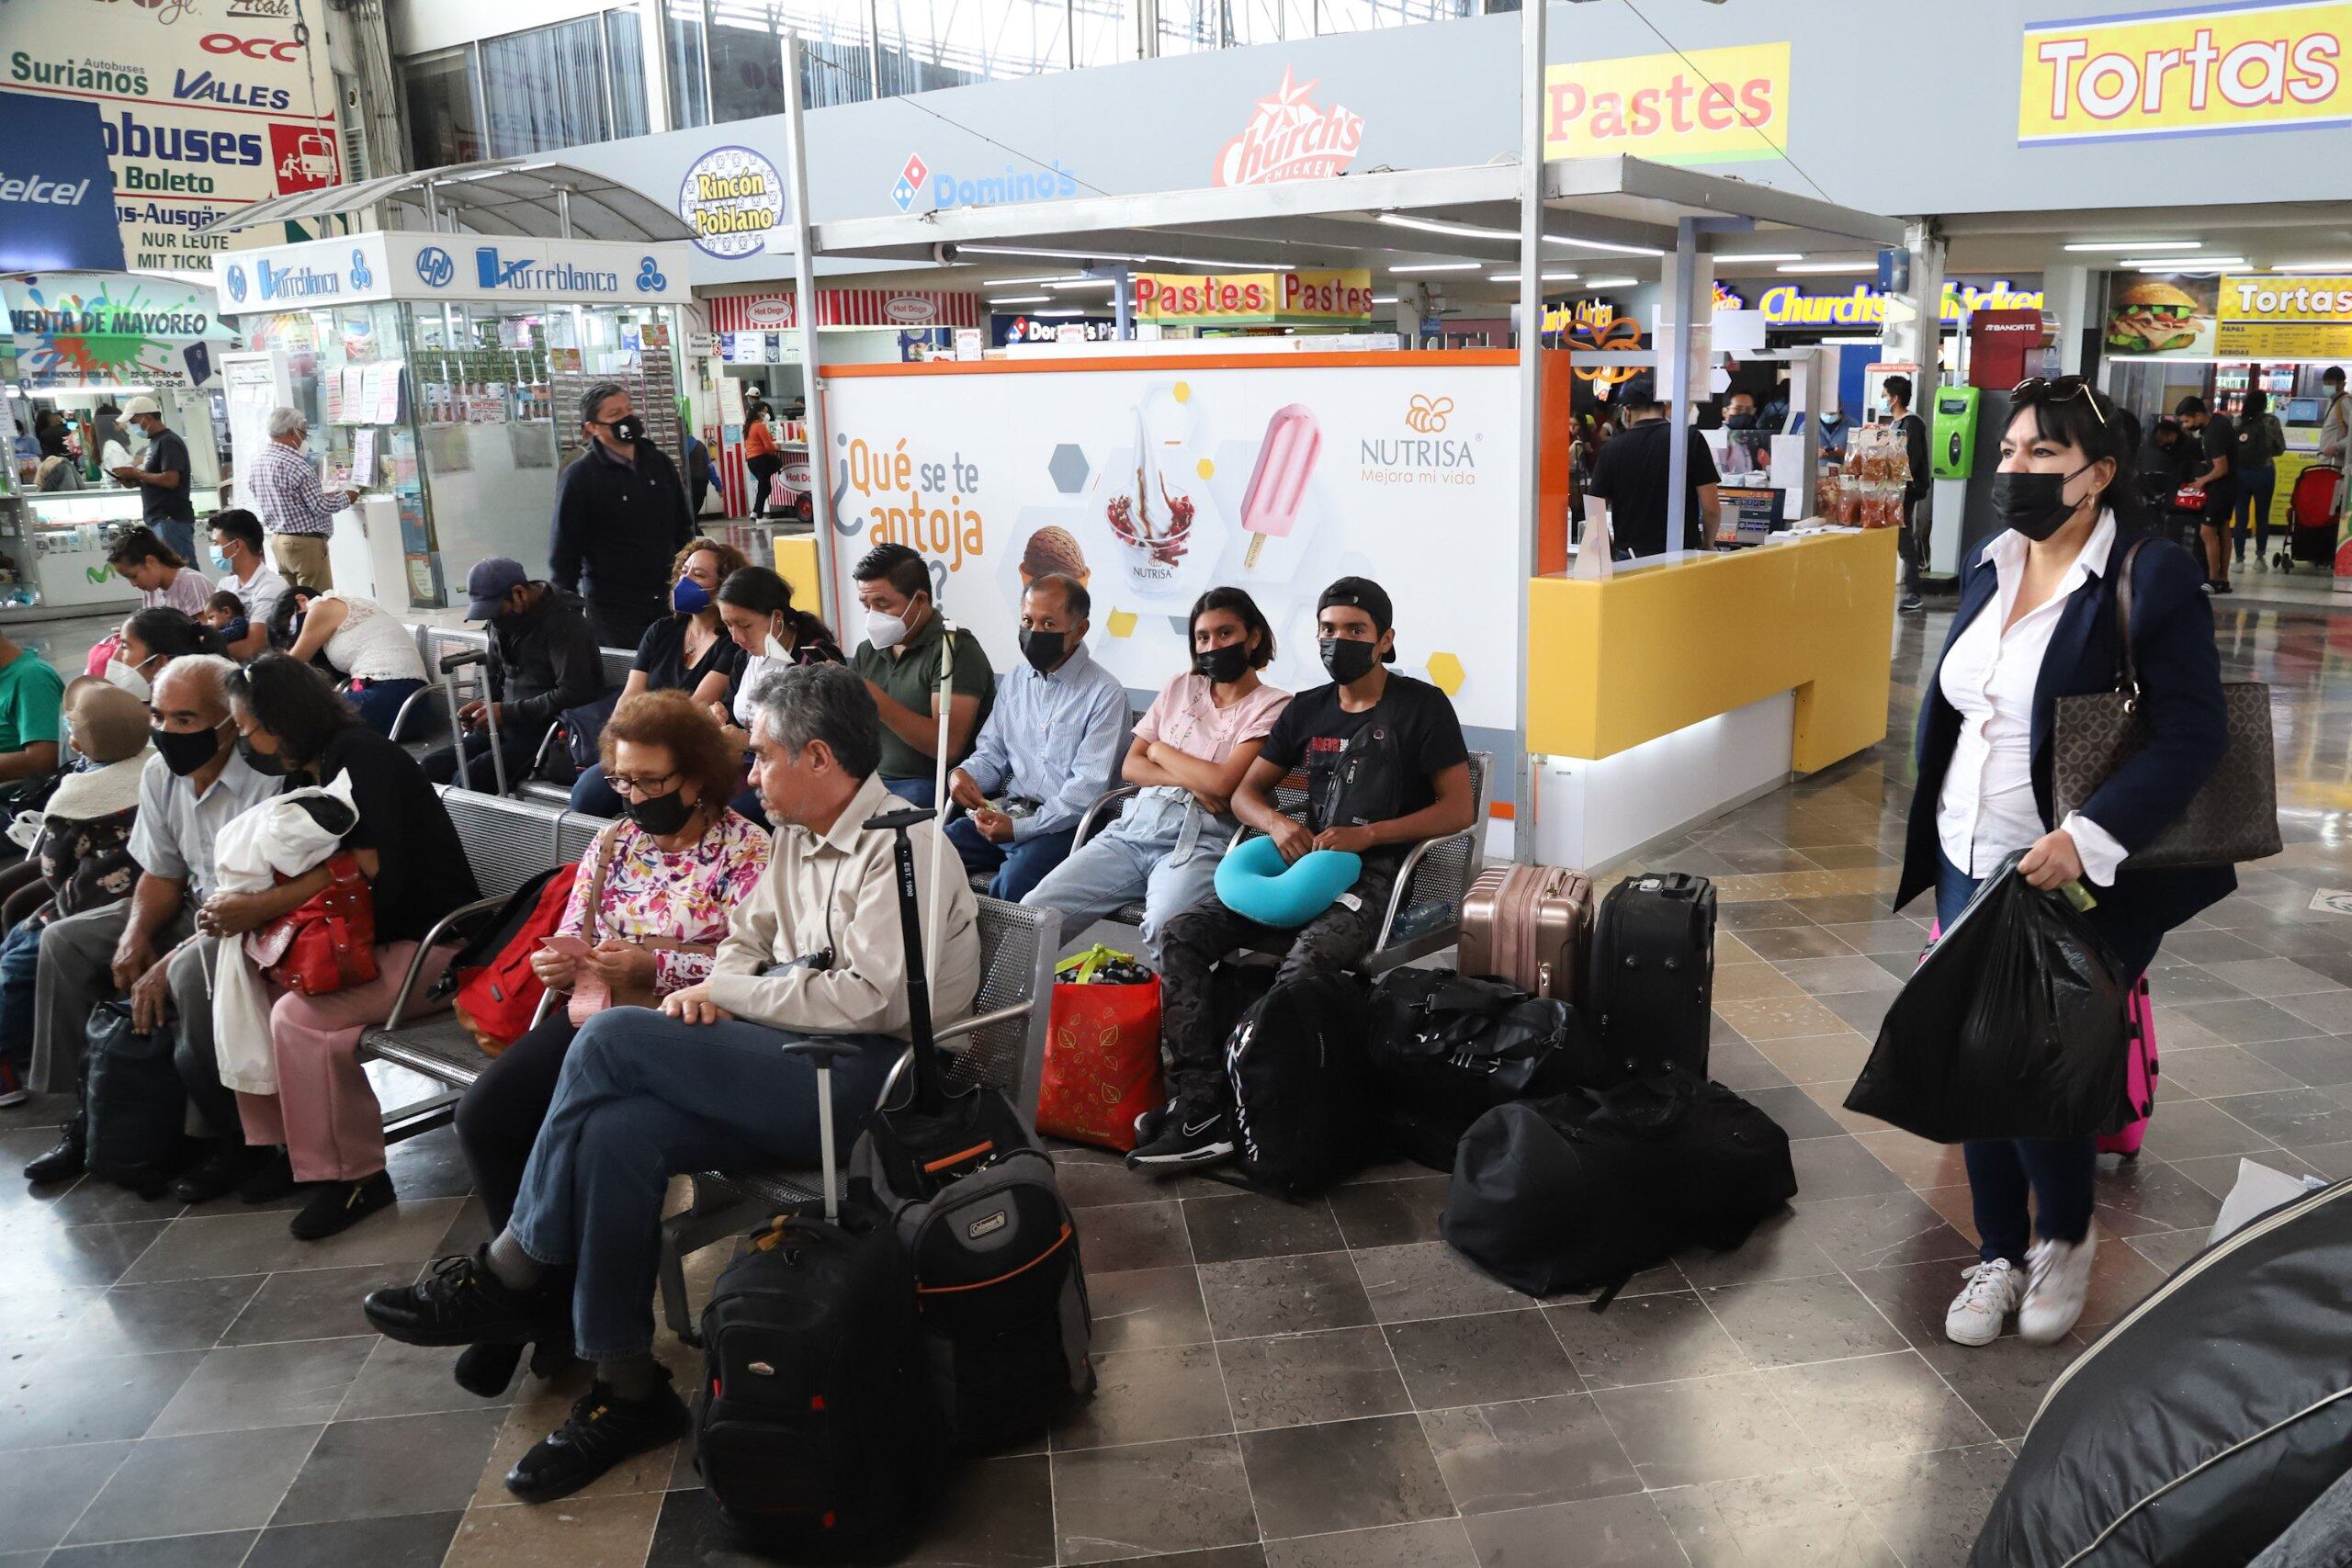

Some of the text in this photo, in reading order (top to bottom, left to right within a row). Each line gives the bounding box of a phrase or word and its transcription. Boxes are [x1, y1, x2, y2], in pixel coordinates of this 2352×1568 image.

[199, 33, 303, 62] OCC
[11, 51, 148, 96] Surianos
[84, 58, 145, 74] Autobuses
[2039, 28, 2340, 120] Tortas
[173, 69, 290, 109] VALLES
[1547, 73, 1772, 141] Pastes
[1218, 104, 1364, 186] Church's
[126, 166, 214, 194] Boleto
[697, 166, 767, 202] Rincón
[933, 157, 1078, 209] Domino's
[1265, 161, 1335, 184] CHICKEN
[694, 205, 774, 235] Poblano
[142, 232, 229, 250] NUR LEUTE
[138, 254, 166, 268] MIT
[503, 259, 617, 292] Torreblanca
[909, 305, 928, 313] Dogs
[1136, 276, 1263, 313] Pastes
[1285, 274, 1374, 314] Pastes
[1759, 284, 1885, 324] Church's
[2237, 284, 2352, 313] Tortas
[9, 310, 208, 335] VENTA DE MAYOREO
[767, 307, 784, 315] Dogs
[1362, 439, 1476, 468] NUTRISA
[786, 473, 800, 482] Hot
[921, 463, 946, 492] se
[953, 451, 979, 493] te
[1362, 468, 1476, 485] Mejora mi vida
[869, 491, 983, 572] antoja
[1133, 566, 1172, 580] NUTRISA
[903, 862, 914, 897] EST. 1900
